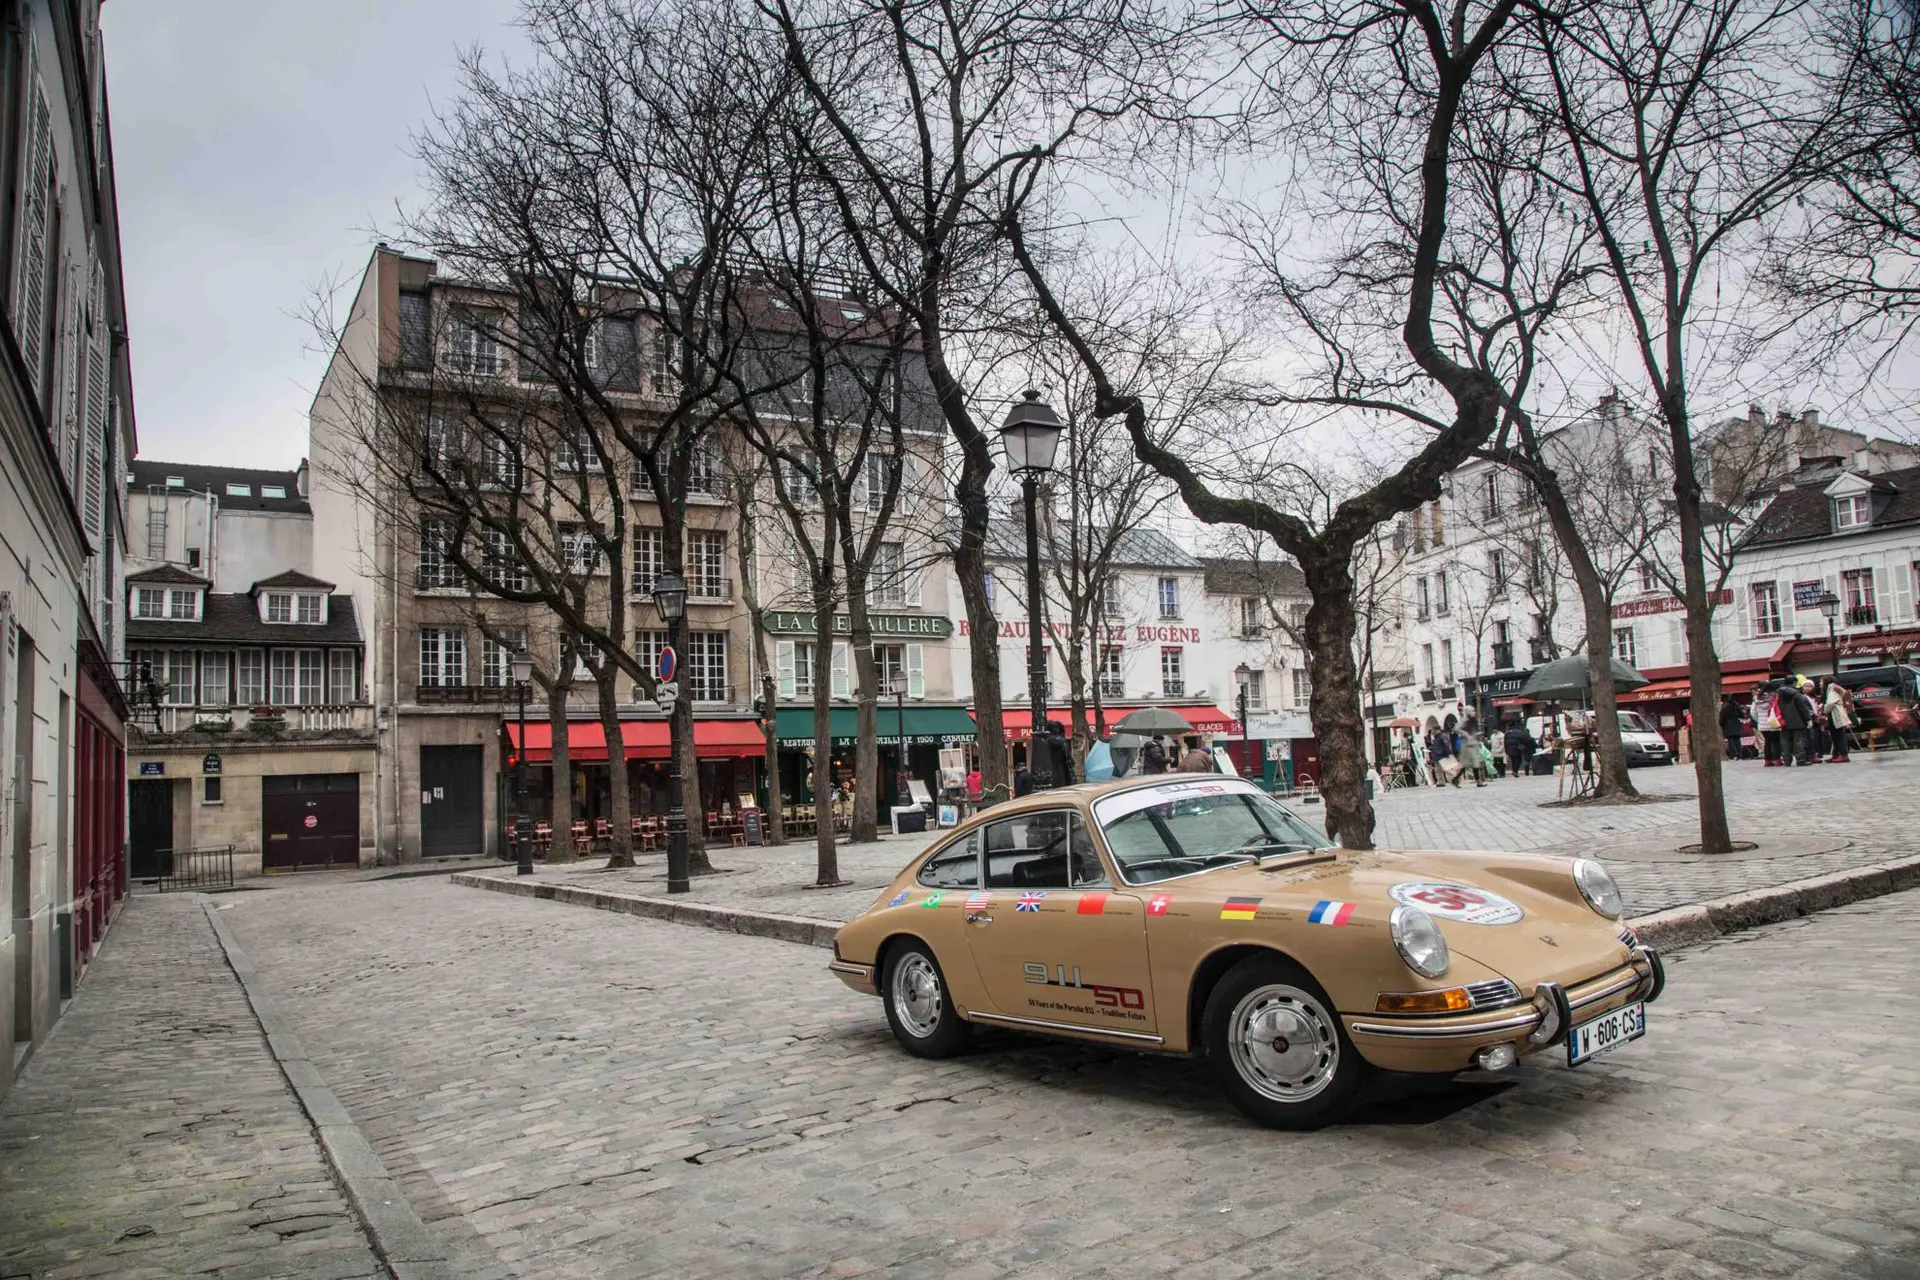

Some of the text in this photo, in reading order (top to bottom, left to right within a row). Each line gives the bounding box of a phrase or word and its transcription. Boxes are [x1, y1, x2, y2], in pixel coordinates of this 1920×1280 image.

[777, 614, 942, 633] LA CEAILLERE
[1137, 625, 1201, 643] EUGÈNE
[1197, 722, 1224, 732] GLACES
[782, 738, 816, 747] RESTAUR
[839, 737, 850, 746] LA
[917, 735, 934, 744] 1900
[941, 734, 975, 743] CABARET
[1024, 962, 1145, 1010] 911 50
[1035, 999, 1050, 1009] Years
[1084, 1005, 1095, 1014] 911
